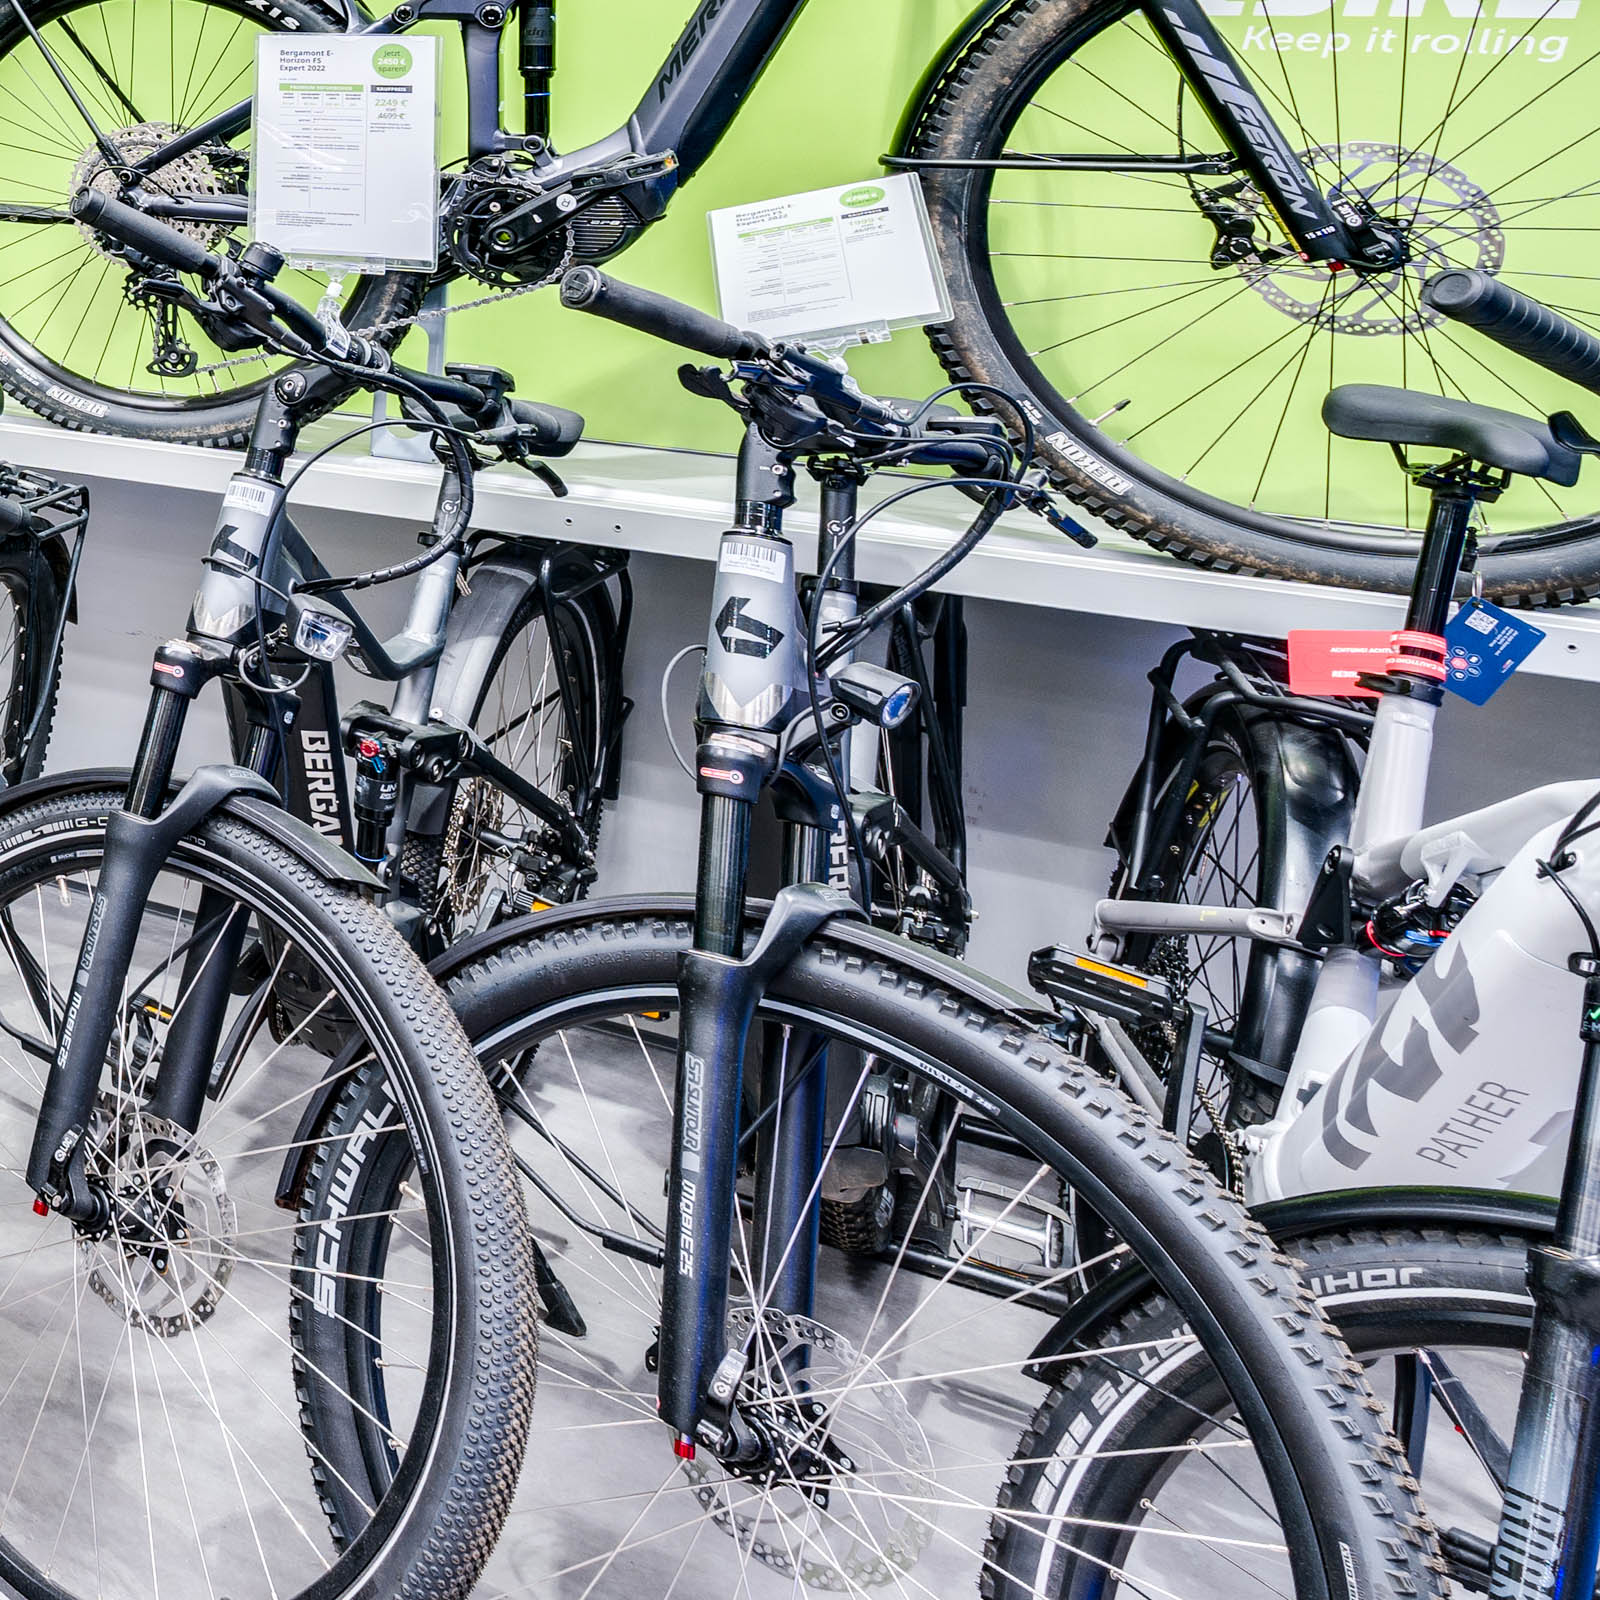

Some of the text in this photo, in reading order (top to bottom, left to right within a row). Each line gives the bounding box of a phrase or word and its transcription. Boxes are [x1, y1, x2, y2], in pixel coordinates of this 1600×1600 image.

[1241, 21, 1572, 66] Keep it rolling
[80, 919, 103, 971] SUNTOUR
[682, 1080, 702, 1151] SUNTOUR
[1415, 1079, 1529, 1170] PATHER
